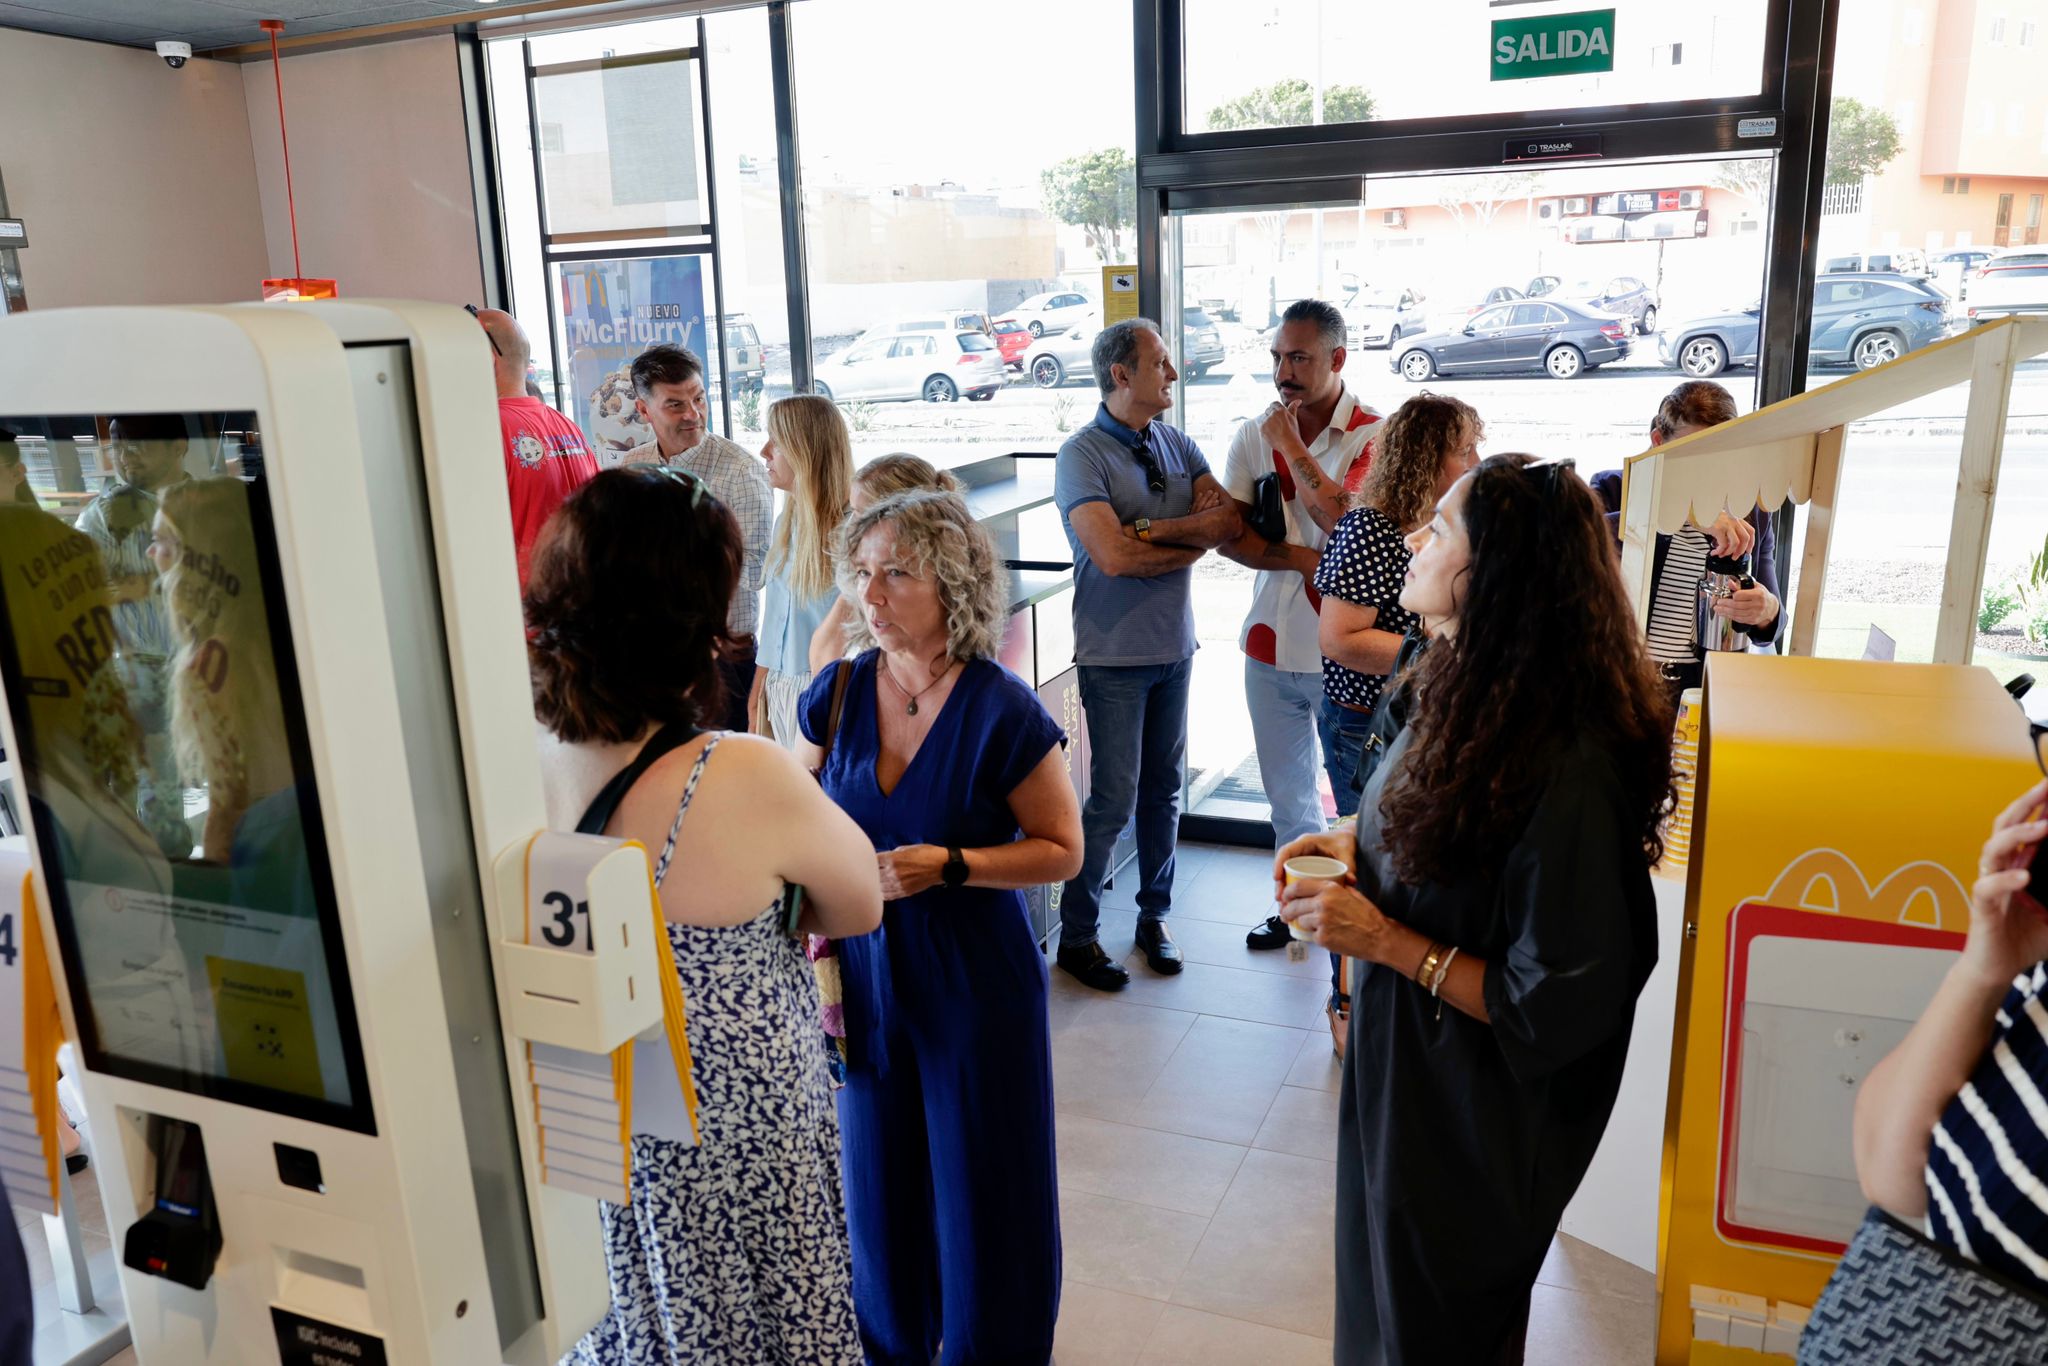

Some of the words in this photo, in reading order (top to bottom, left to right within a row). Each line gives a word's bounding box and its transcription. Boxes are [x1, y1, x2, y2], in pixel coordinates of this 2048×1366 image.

[1495, 27, 1609, 64] SALIDA
[637, 304, 680, 319] NUEVO
[575, 315, 693, 348] McFlurry
